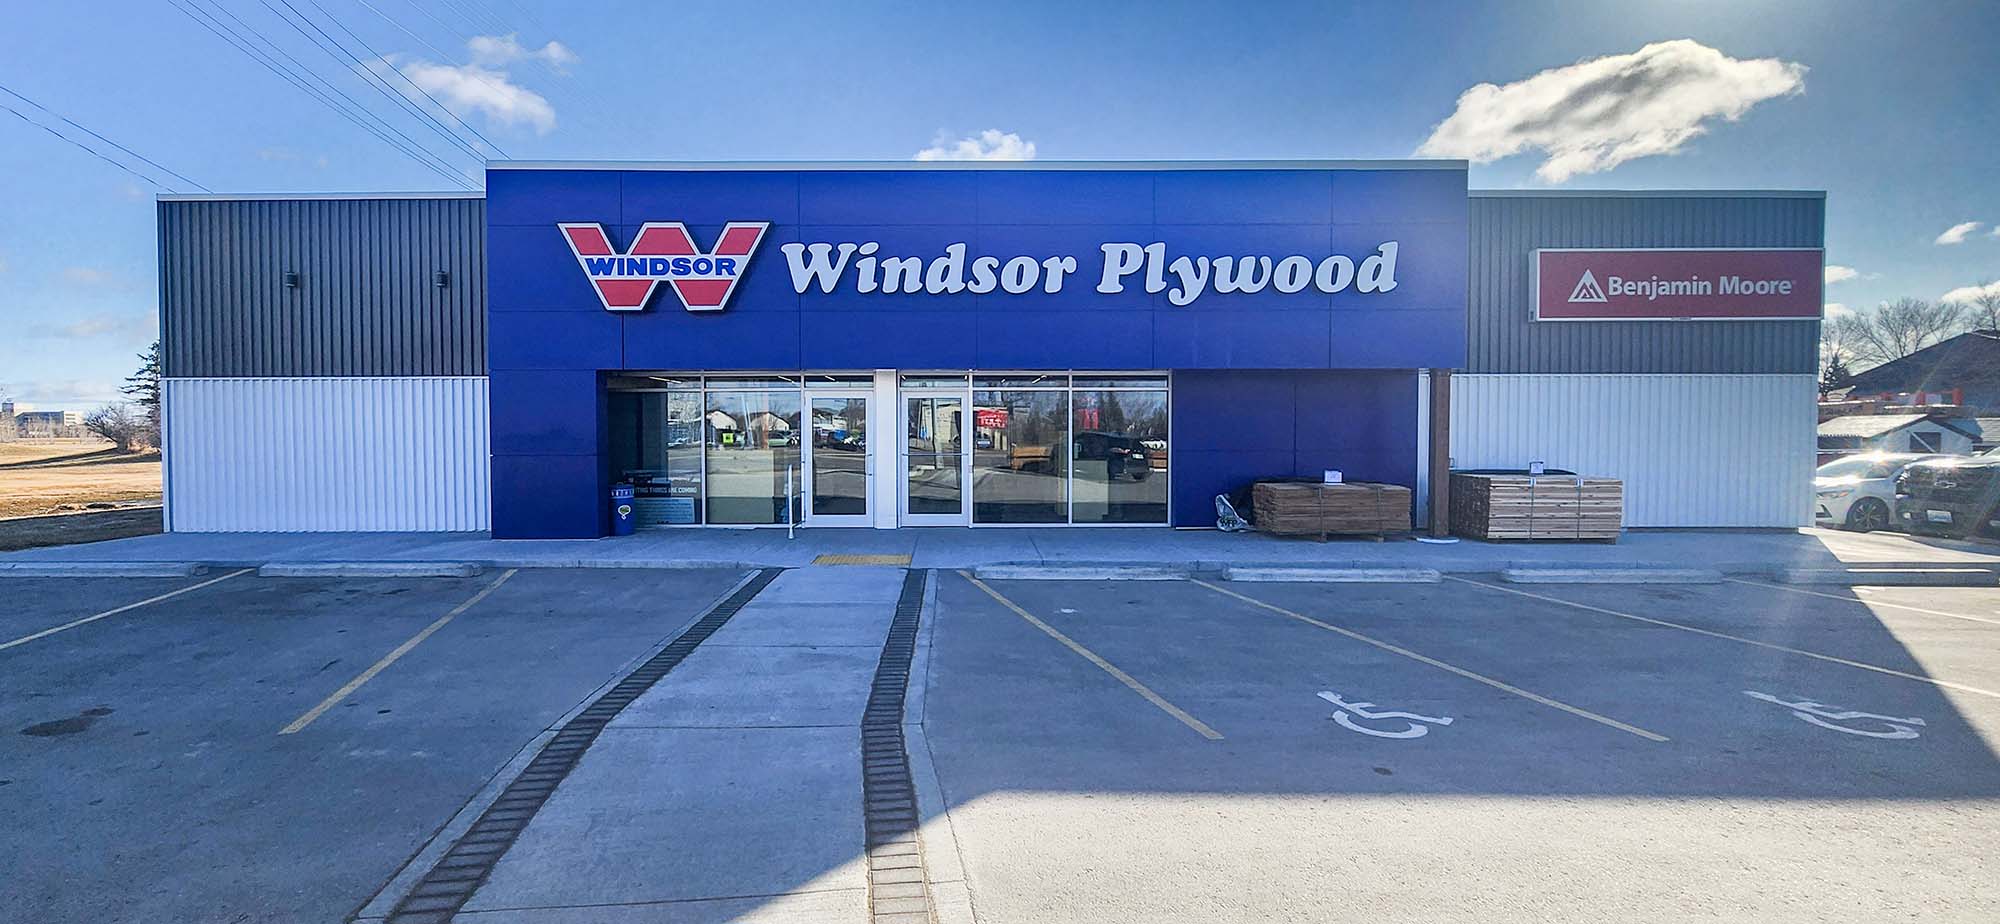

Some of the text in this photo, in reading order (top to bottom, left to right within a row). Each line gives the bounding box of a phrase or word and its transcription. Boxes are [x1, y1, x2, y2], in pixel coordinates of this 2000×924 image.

[584, 257, 737, 276] WINDSOR
[780, 240, 1399, 306] Windsor Plywood
[1608, 275, 1793, 300] Benjamin Moore
